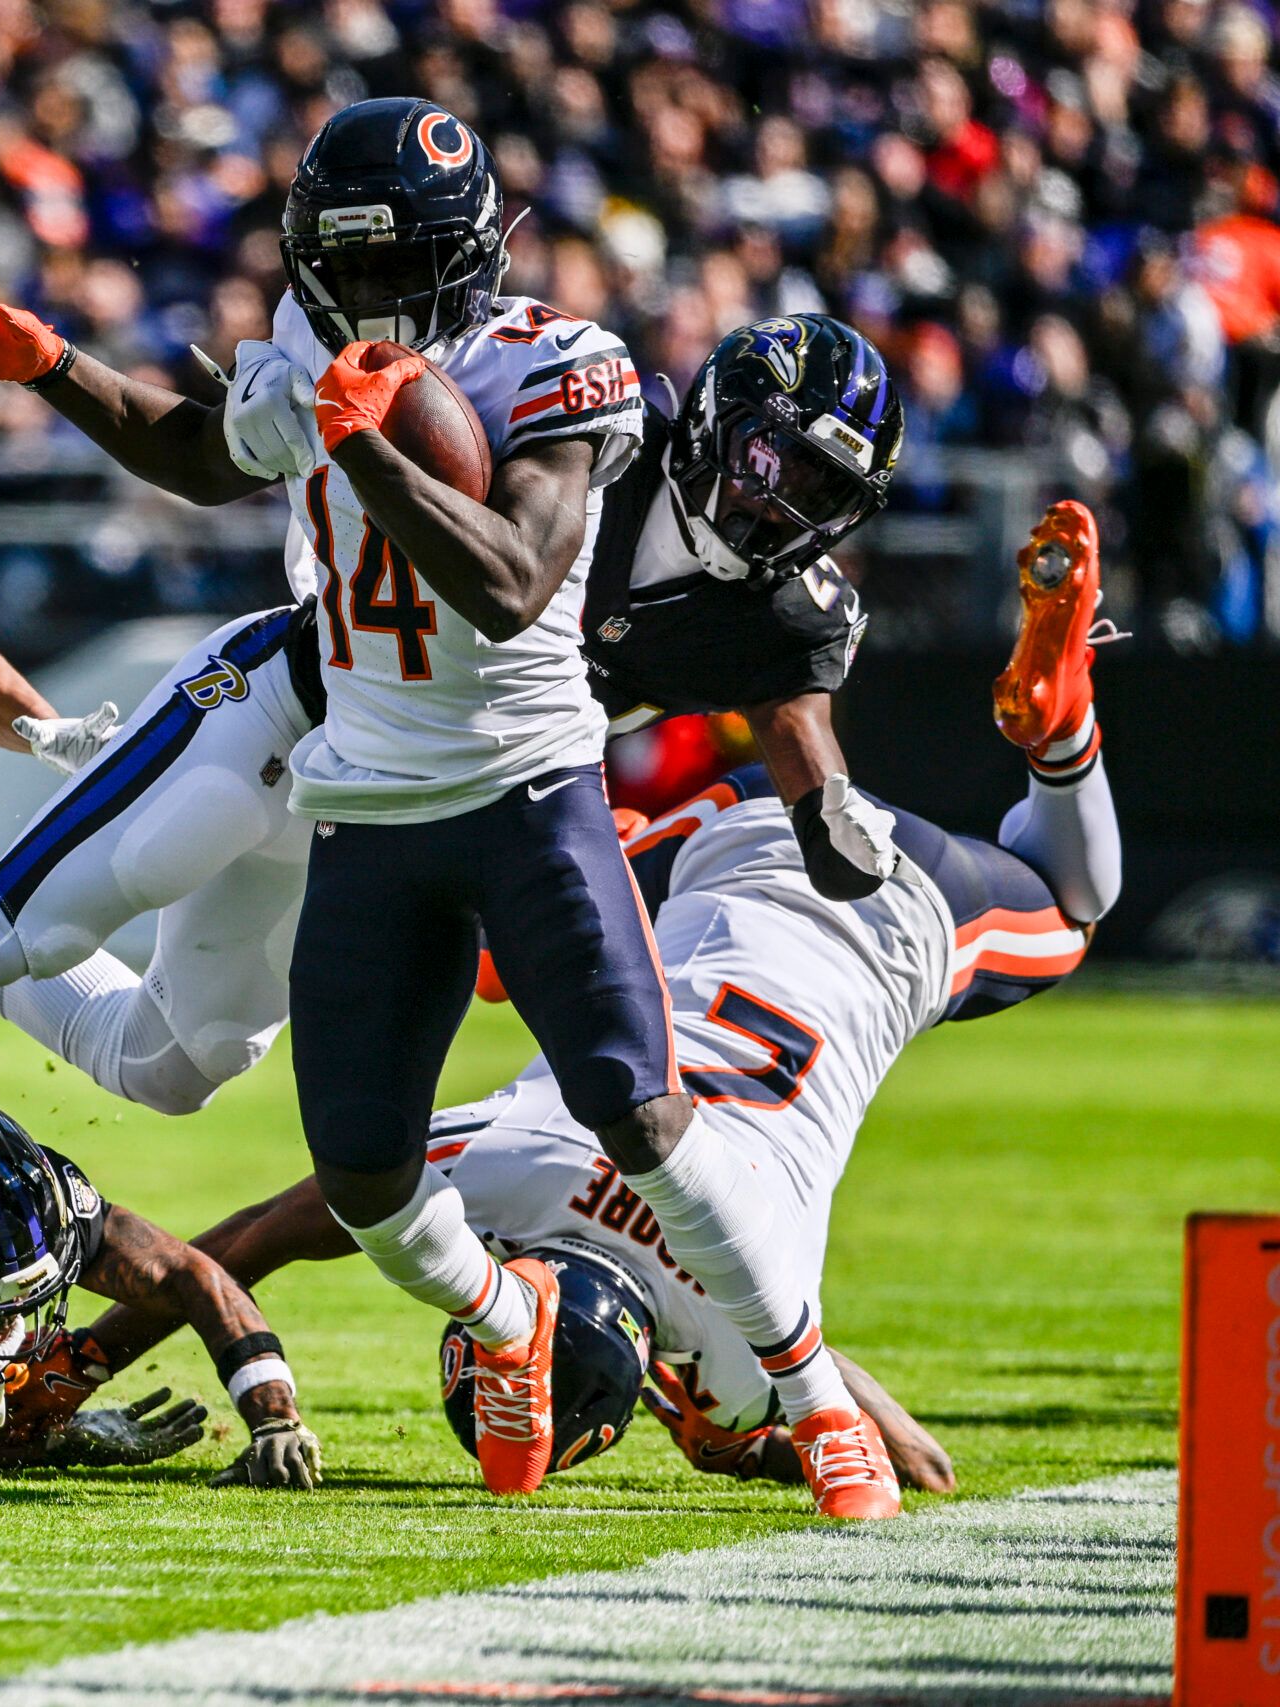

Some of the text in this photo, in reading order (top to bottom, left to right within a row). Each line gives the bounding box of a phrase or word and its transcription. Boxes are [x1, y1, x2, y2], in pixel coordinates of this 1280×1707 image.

[560, 360, 625, 415] GSH
[768, 398, 796, 422] OAKLEY
[306, 464, 439, 682] 14
